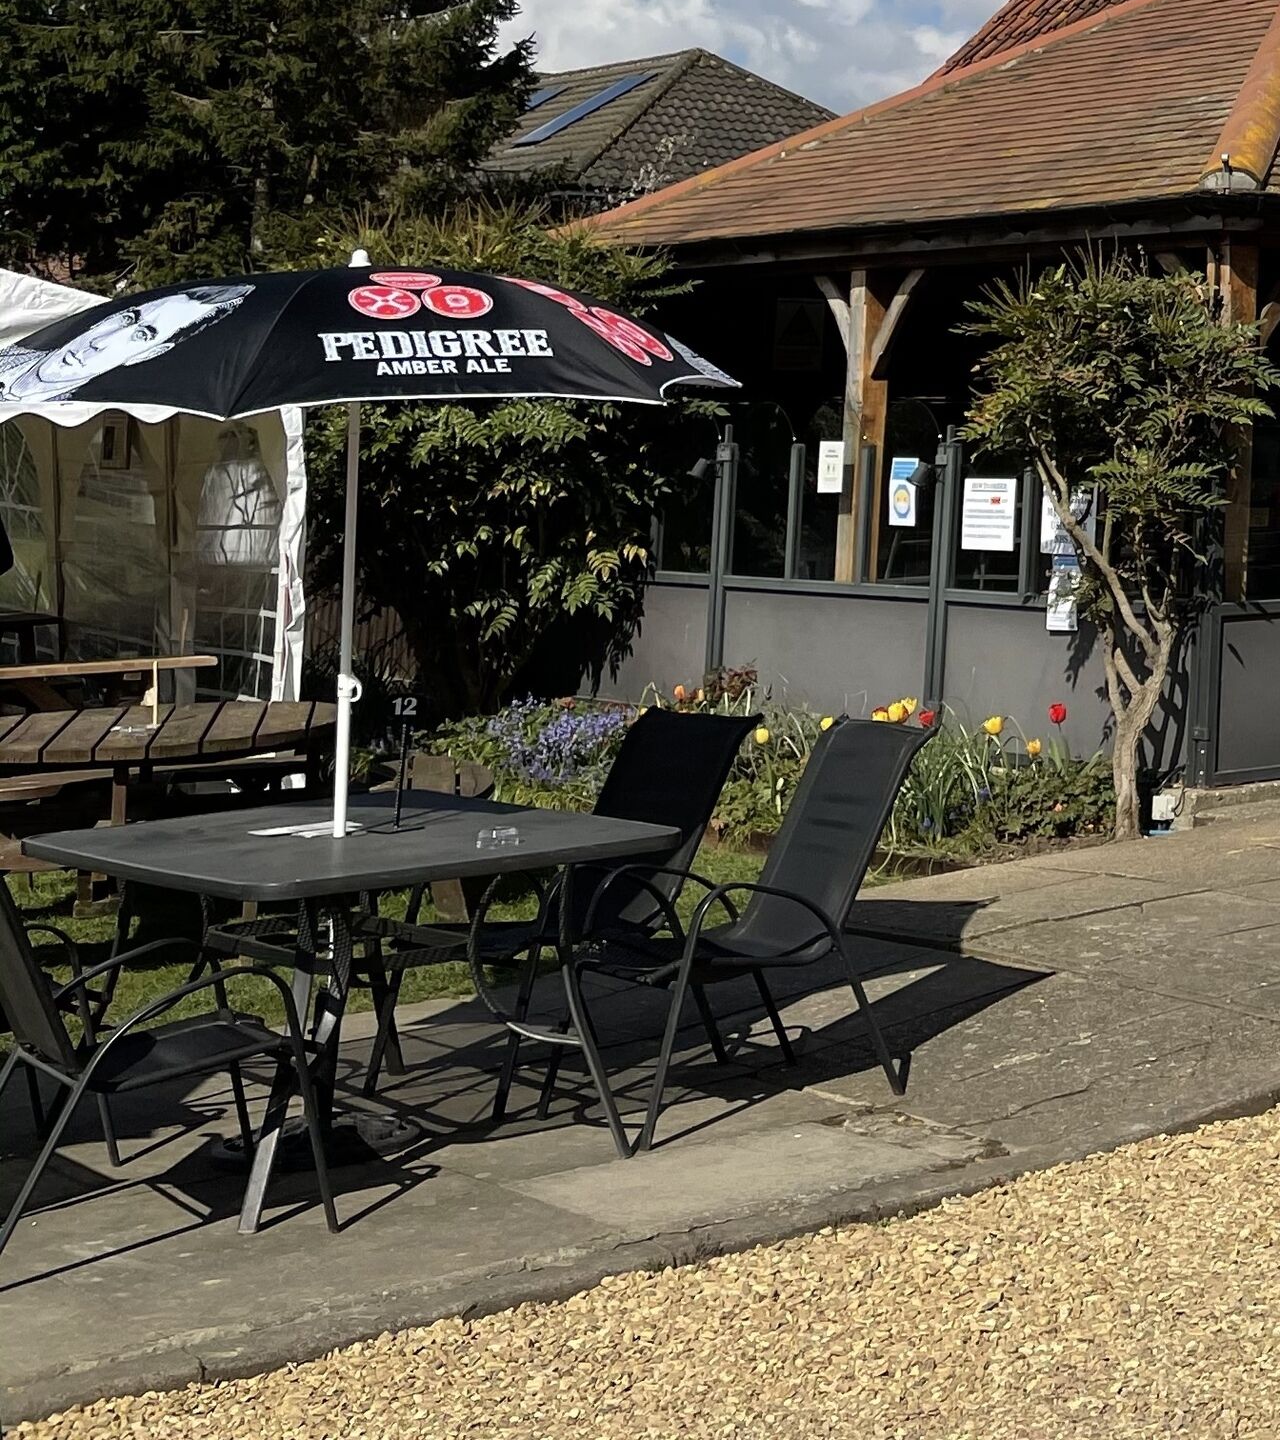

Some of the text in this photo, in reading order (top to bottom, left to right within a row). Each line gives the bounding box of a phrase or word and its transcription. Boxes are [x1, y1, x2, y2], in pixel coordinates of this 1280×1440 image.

[317, 329, 554, 362] PEDIGREE
[376, 358, 513, 376] AMBER ALE
[391, 696, 418, 716] 12
